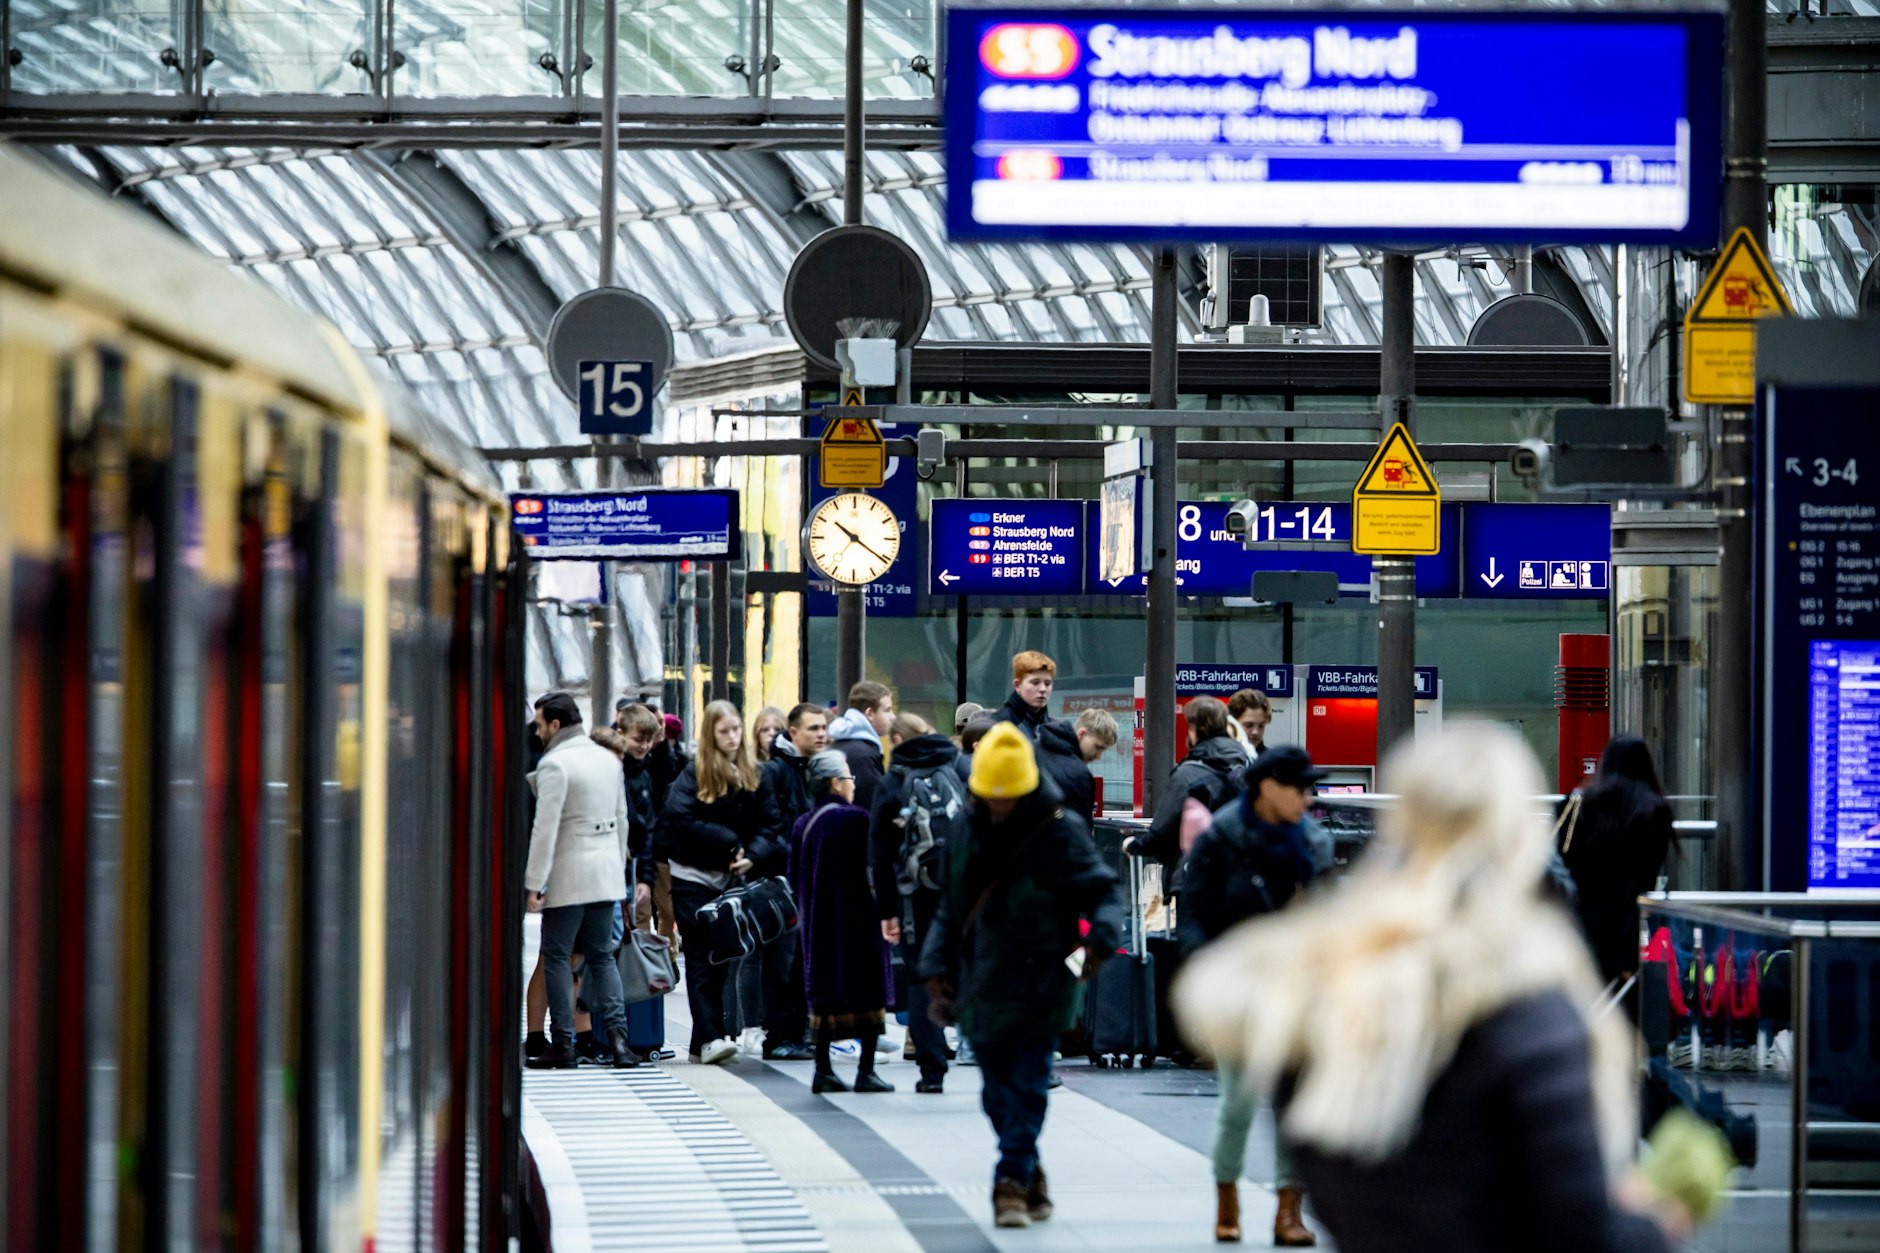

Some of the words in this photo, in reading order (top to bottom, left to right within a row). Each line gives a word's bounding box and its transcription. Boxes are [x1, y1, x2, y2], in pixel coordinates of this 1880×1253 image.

[1087, 24, 1311, 88] Strausberg
[1314, 25, 1418, 78] Nord
[581, 363, 643, 418] 15
[1812, 457, 1859, 486] 3-4
[547, 497, 615, 515] Strausberg
[615, 496, 647, 512] Nord
[1799, 503, 1876, 519] Ebenenplan
[993, 512, 1025, 523] Erkner
[1251, 506, 1336, 541] 11-14
[974, 527, 986, 535] S5
[993, 526, 1047, 539] Strausberg
[1049, 526, 1075, 537] Nord
[993, 540, 1053, 550] Ahrensfelde
[973, 554, 986, 563] S9
[1004, 554, 1025, 564] BER
[1027, 554, 1048, 564] T1-2
[1050, 554, 1065, 564] via
[1004, 567, 1025, 577] BER
[1027, 567, 1040, 577] T5
[1521, 578, 1542, 586] Polizei
[872, 584, 894, 593] T1-2
[896, 584, 911, 594] via
[872, 597, 886, 607] T5
[1175, 670, 1259, 682] VBB-Fahrkarten
[1318, 671, 1378, 683] VBB-Fahrk
[1176, 682, 1239, 692] ickets/Billets/Biglietti
[1317, 684, 1378, 693] Tickets/Billets/Biglie
